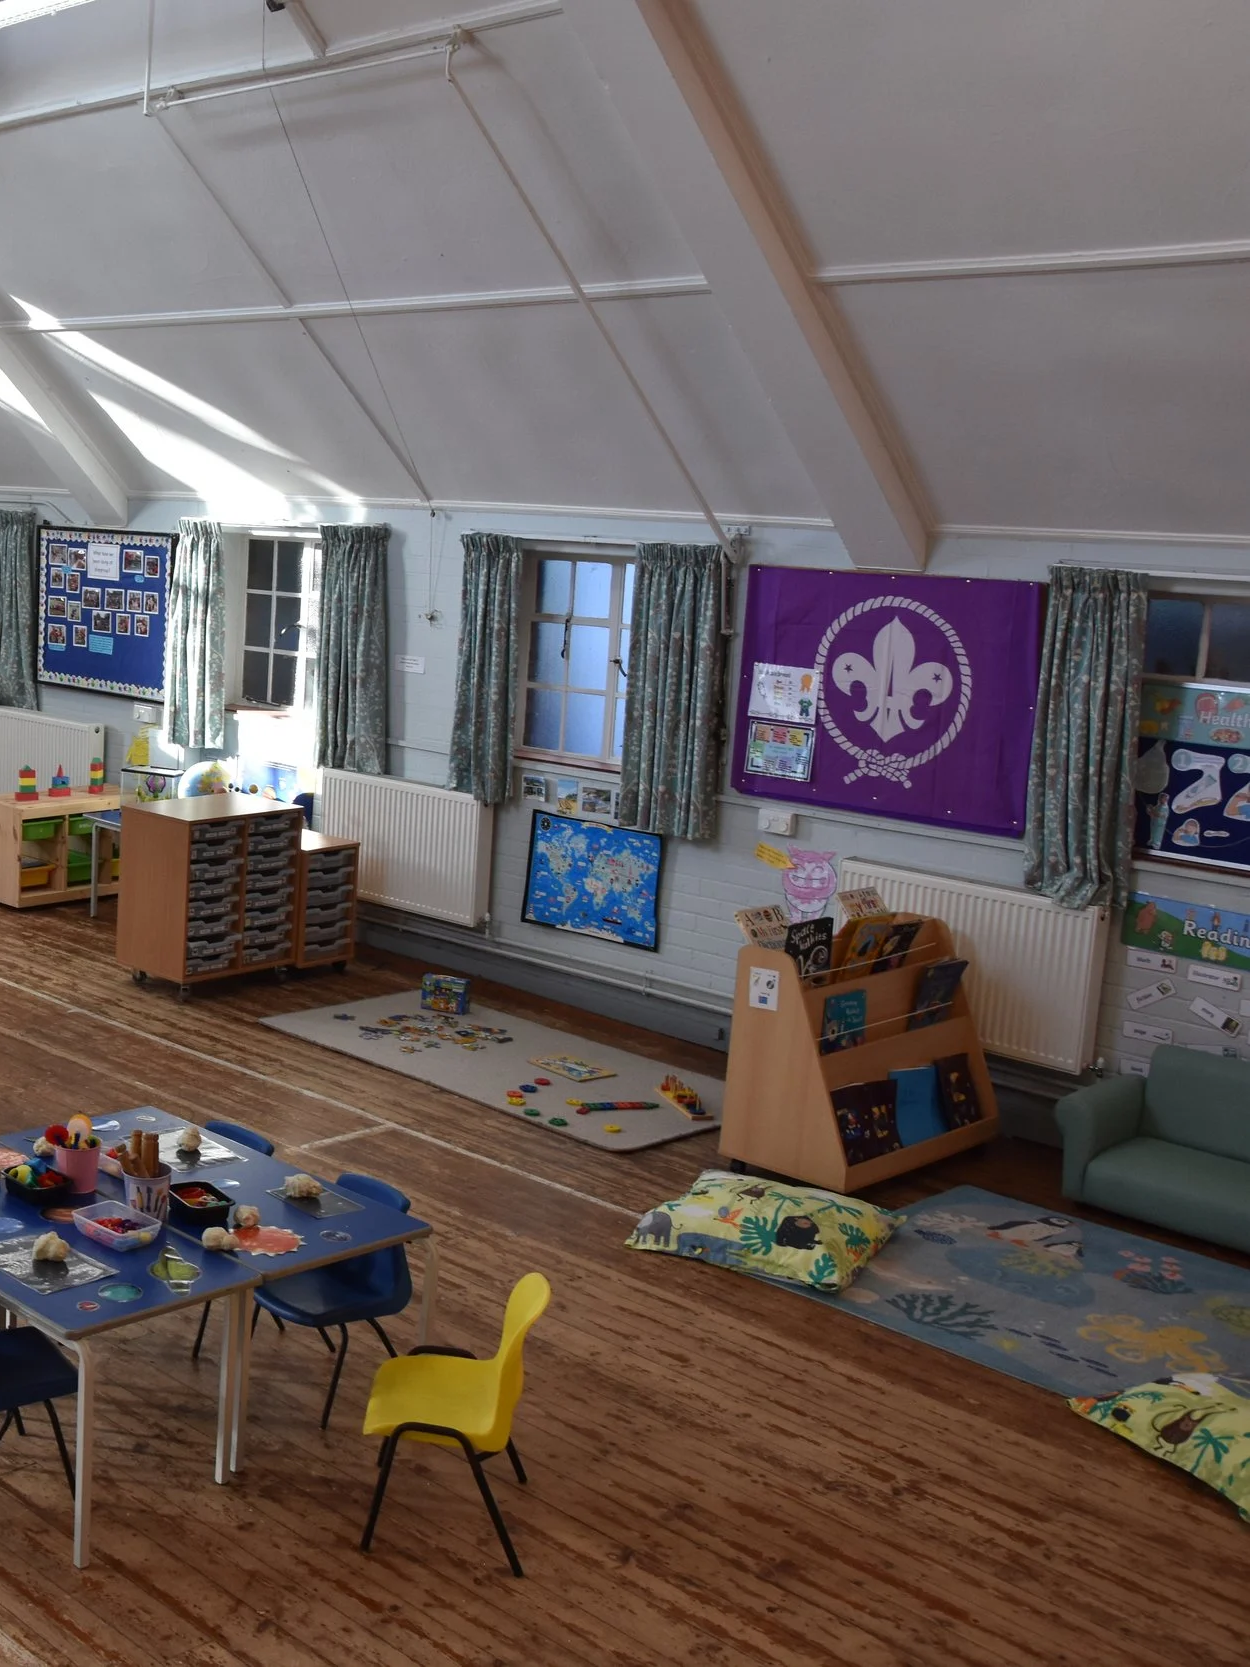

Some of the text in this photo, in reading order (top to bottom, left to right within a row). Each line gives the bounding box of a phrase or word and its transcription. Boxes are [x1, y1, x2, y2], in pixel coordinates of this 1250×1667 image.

[1178, 754, 1187, 767] 1
[1233, 757, 1244, 770] 2
[745, 907, 784, 926] A B
[791, 924, 815, 944] Space
